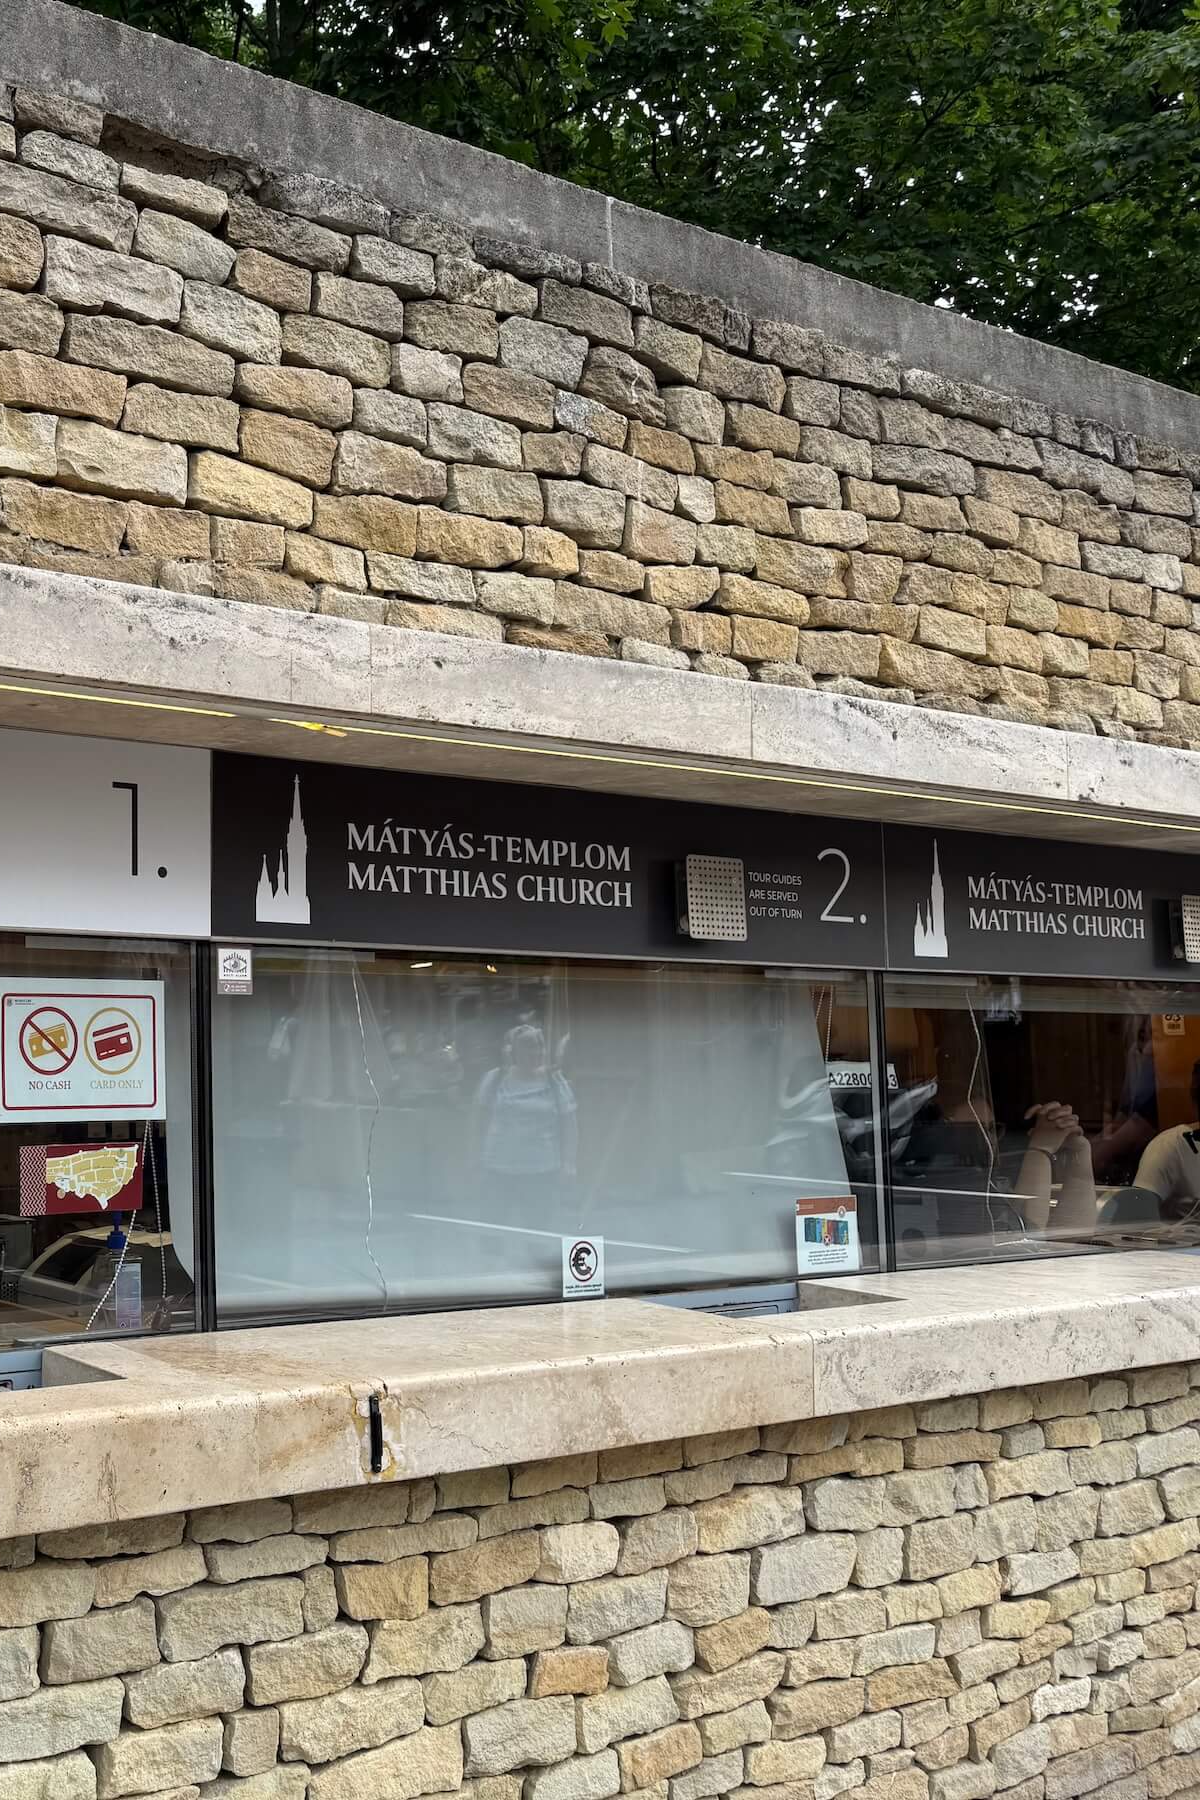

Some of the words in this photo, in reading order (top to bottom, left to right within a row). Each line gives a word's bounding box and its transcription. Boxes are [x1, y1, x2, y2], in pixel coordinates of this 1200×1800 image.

[112, 782, 167, 878] 1.
[347, 818, 631, 871] MÁTYÁS-TEMPLOM
[348, 863, 507, 899] MATTHIAS
[517, 876, 633, 908] CHURCH
[748, 871, 770, 883] TOUR
[772, 874, 802, 886] GUIDES
[816, 848, 867, 924] 2.
[968, 872, 1143, 911] MÁTYÁS-TEMPLOM
[749, 889, 766, 899] ARE
[767, 890, 798, 902] SERVED
[750, 906, 766, 917] OUT
[768, 907, 780, 917] OF
[781, 908, 802, 919] TURN
[969, 908, 1068, 935] MATTHIAS
[1072, 914, 1145, 940] CHURCH
[29, 1081, 44, 1090] NO
[45, 1080, 71, 1090] CASH
[90, 1080, 117, 1089] CARD
[118, 1080, 144, 1089] ONLY
